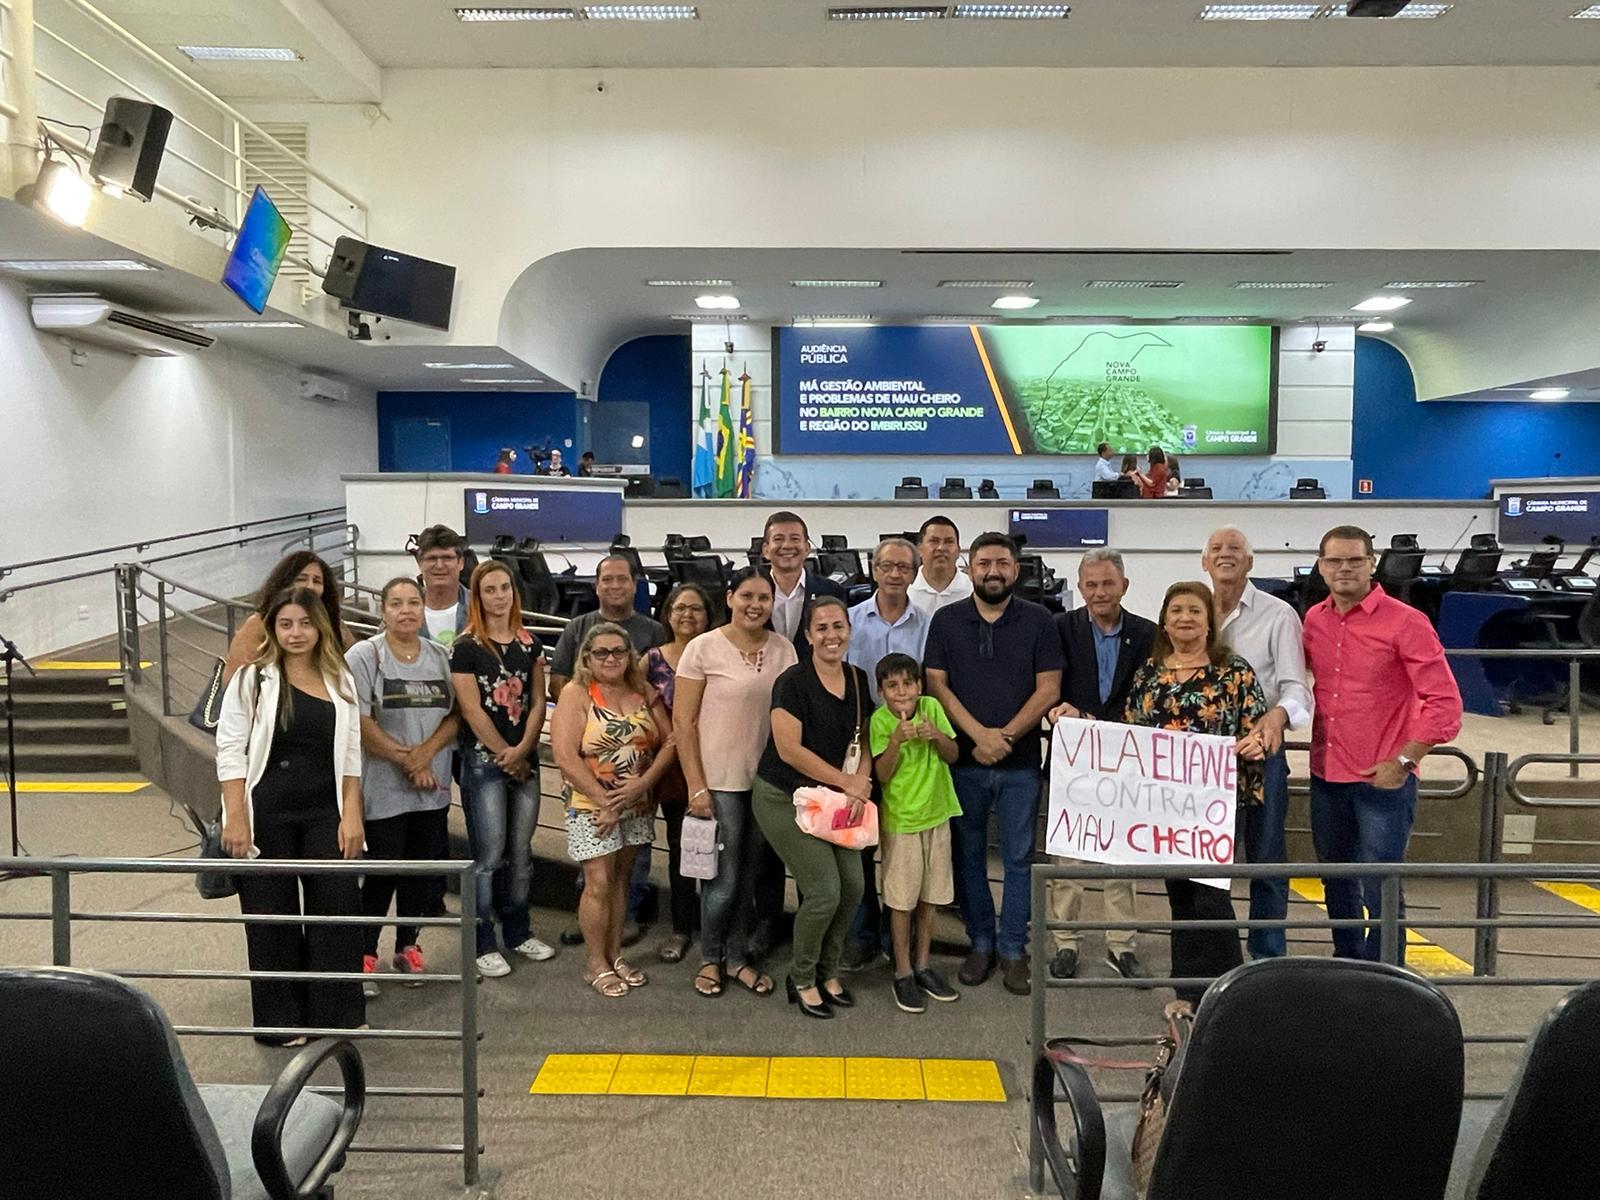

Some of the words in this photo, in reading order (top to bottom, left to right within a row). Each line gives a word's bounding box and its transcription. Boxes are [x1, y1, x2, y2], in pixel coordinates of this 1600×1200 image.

[800, 344, 847, 353] AUDIÊNCIA
[800, 352, 848, 364] PÚBLICA
[1105, 361, 1131, 369] NOVA
[800, 380, 818, 392] MÁ
[820, 380, 863, 392] GESTÃO
[865, 381, 926, 392] AMBIENTAL
[800, 394, 808, 404] E
[808, 394, 874, 404] PROBLEMAS
[875, 394, 890, 404] DE
[892, 394, 918, 404] MAU
[920, 394, 960, 404] CHEIRO
[800, 407, 818, 418] NO
[820, 407, 860, 418] BAIRRO
[861, 407, 894, 418] NOVA
[894, 407, 936, 418] CAMPO
[938, 407, 984, 418] GRANDE
[800, 421, 808, 431] E
[808, 418, 850, 431] REGIÃO
[851, 421, 870, 431] DO
[870, 421, 928, 431] IMBIRUSSU
[1066, 774, 1196, 817] CONTRA
[1205, 799, 1228, 826] O
[1050, 808, 1115, 852] MAU
